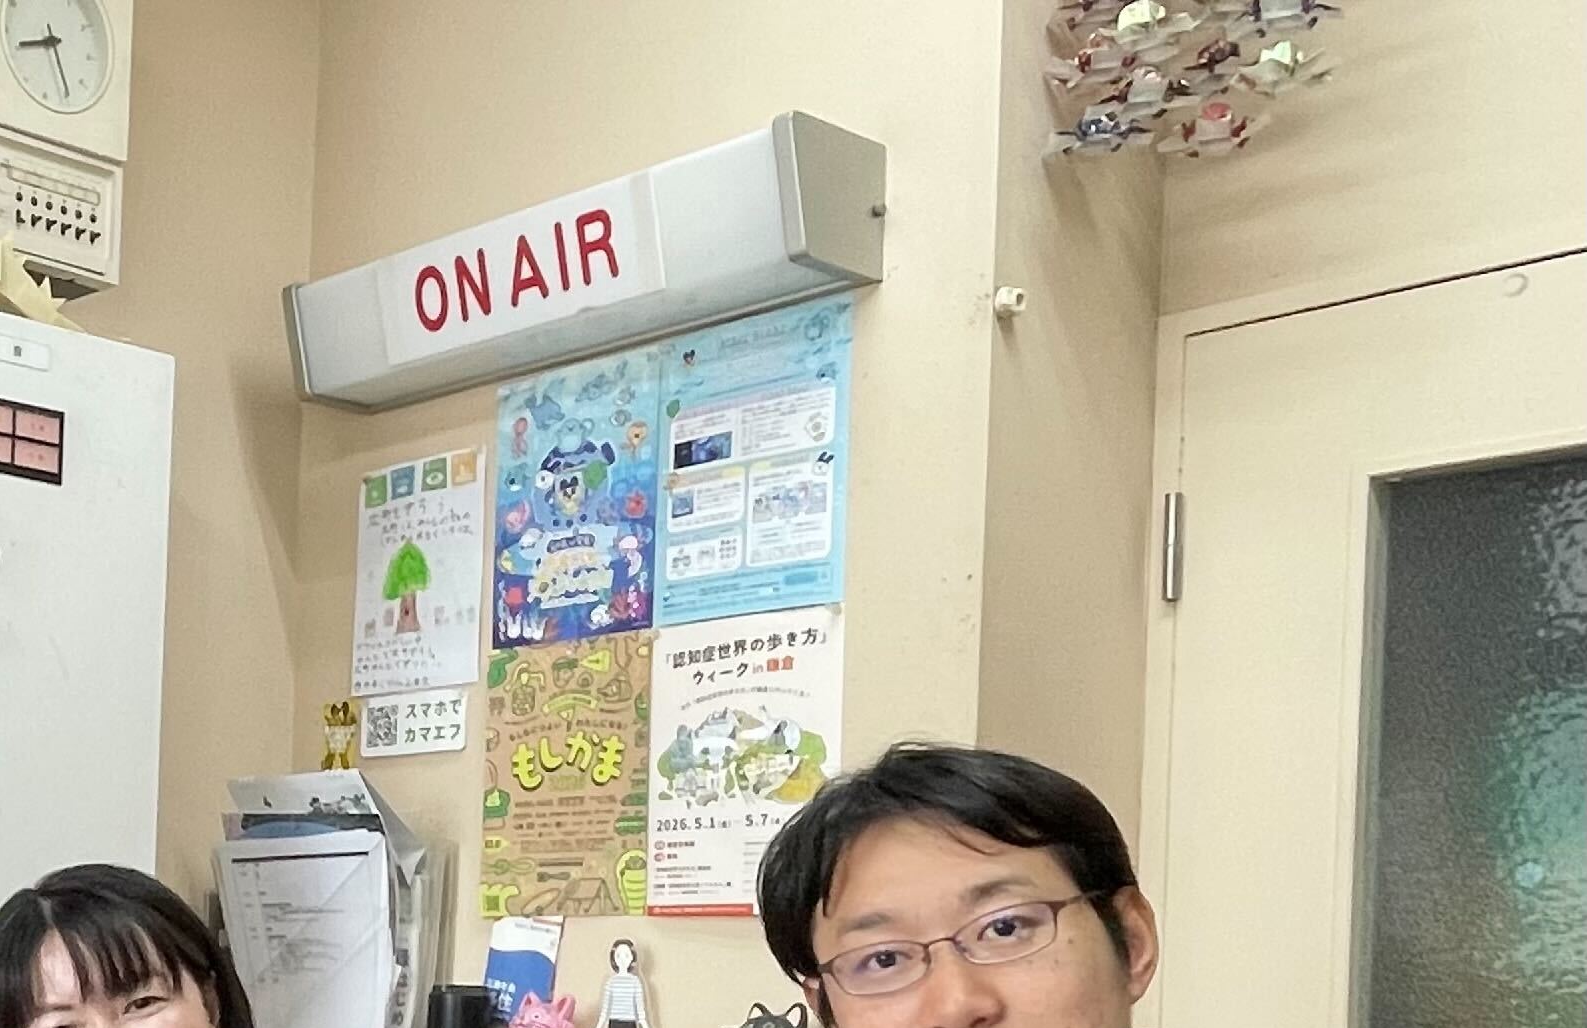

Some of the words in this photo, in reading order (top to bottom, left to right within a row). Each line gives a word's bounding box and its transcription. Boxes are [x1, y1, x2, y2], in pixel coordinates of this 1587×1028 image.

[415, 248, 492, 332] ON
[510, 209, 619, 307] AIR
[405, 699, 462, 719] スマホで
[405, 724, 461, 743] カマエフ
[512, 731, 625, 791] もしかま
